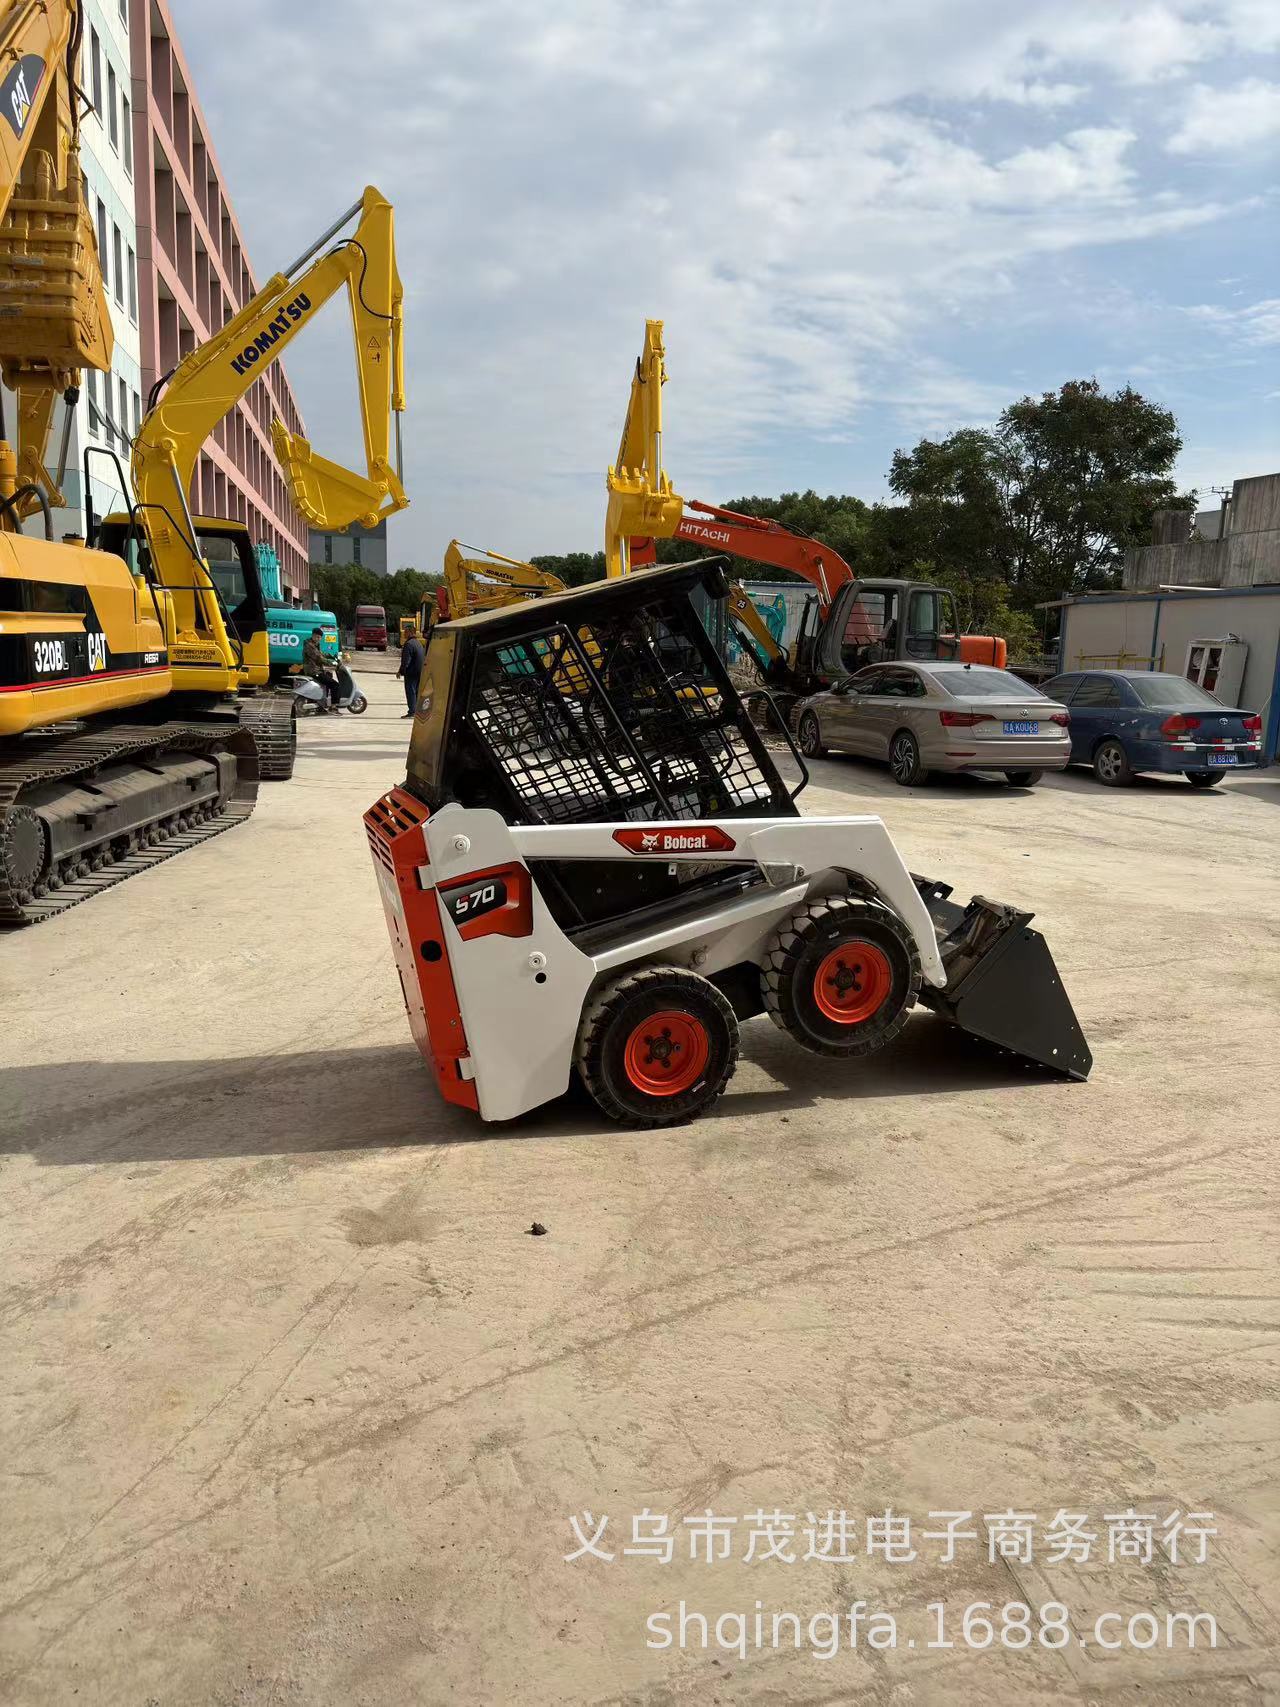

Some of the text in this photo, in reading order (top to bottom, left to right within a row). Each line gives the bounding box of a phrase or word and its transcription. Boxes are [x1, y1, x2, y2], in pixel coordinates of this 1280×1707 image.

[11, 64, 31, 129] CAT
[230, 292, 312, 376] KOMATSU
[680, 522, 730, 543] HITACHI
[486, 569, 514, 580] KOMATSU
[87, 632, 107, 672] CAT
[663, 834, 707, 850] Bobcat
[455, 885, 495, 915] S70
